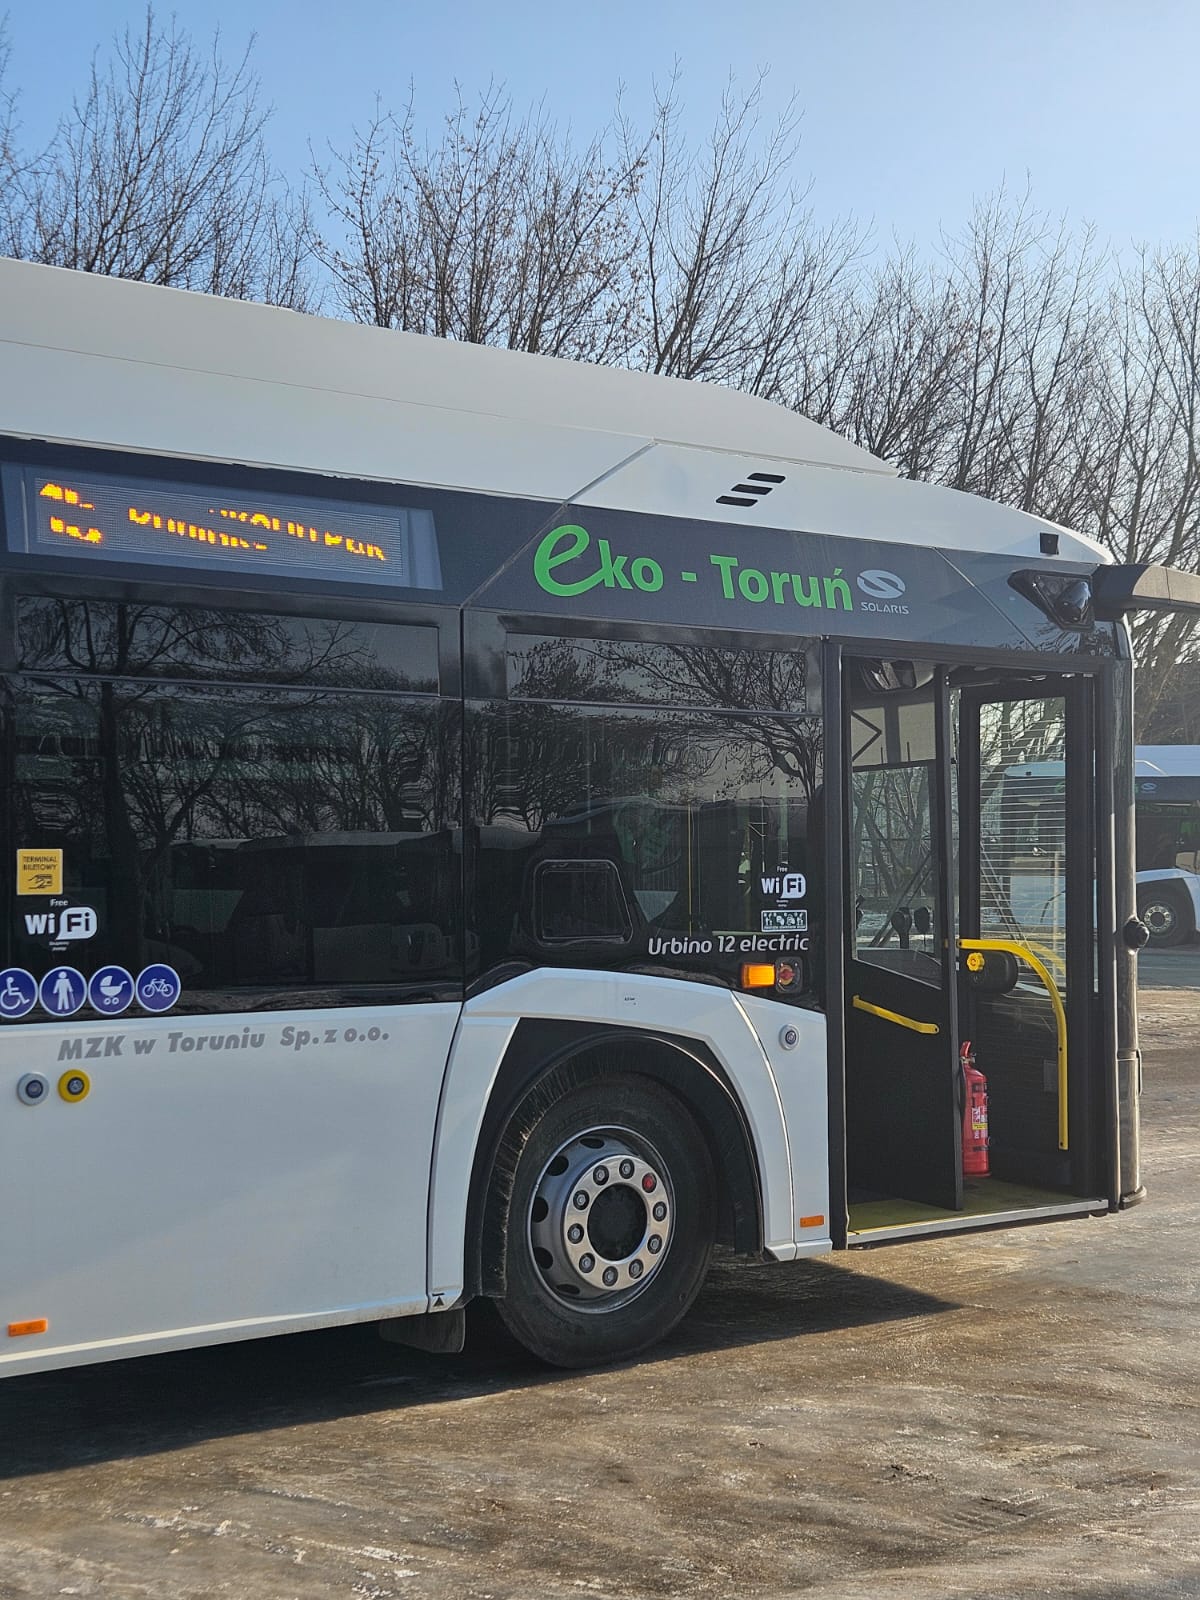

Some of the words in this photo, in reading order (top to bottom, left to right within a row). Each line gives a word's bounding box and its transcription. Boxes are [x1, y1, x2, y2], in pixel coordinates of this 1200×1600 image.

[533, 524, 664, 597] eko
[709, 554, 854, 610] Toruń
[860, 601, 910, 615] SOLARIS
[49, 898, 69, 906] Free
[648, 937, 713, 956] Urbino
[718, 935, 736, 953] 12
[739, 934, 809, 952] electric
[57, 1035, 125, 1061] MZK
[133, 1038, 156, 1055] w
[167, 1027, 265, 1053] Toruniu
[279, 1026, 319, 1051] Sp.
[324, 1029, 339, 1044] z
